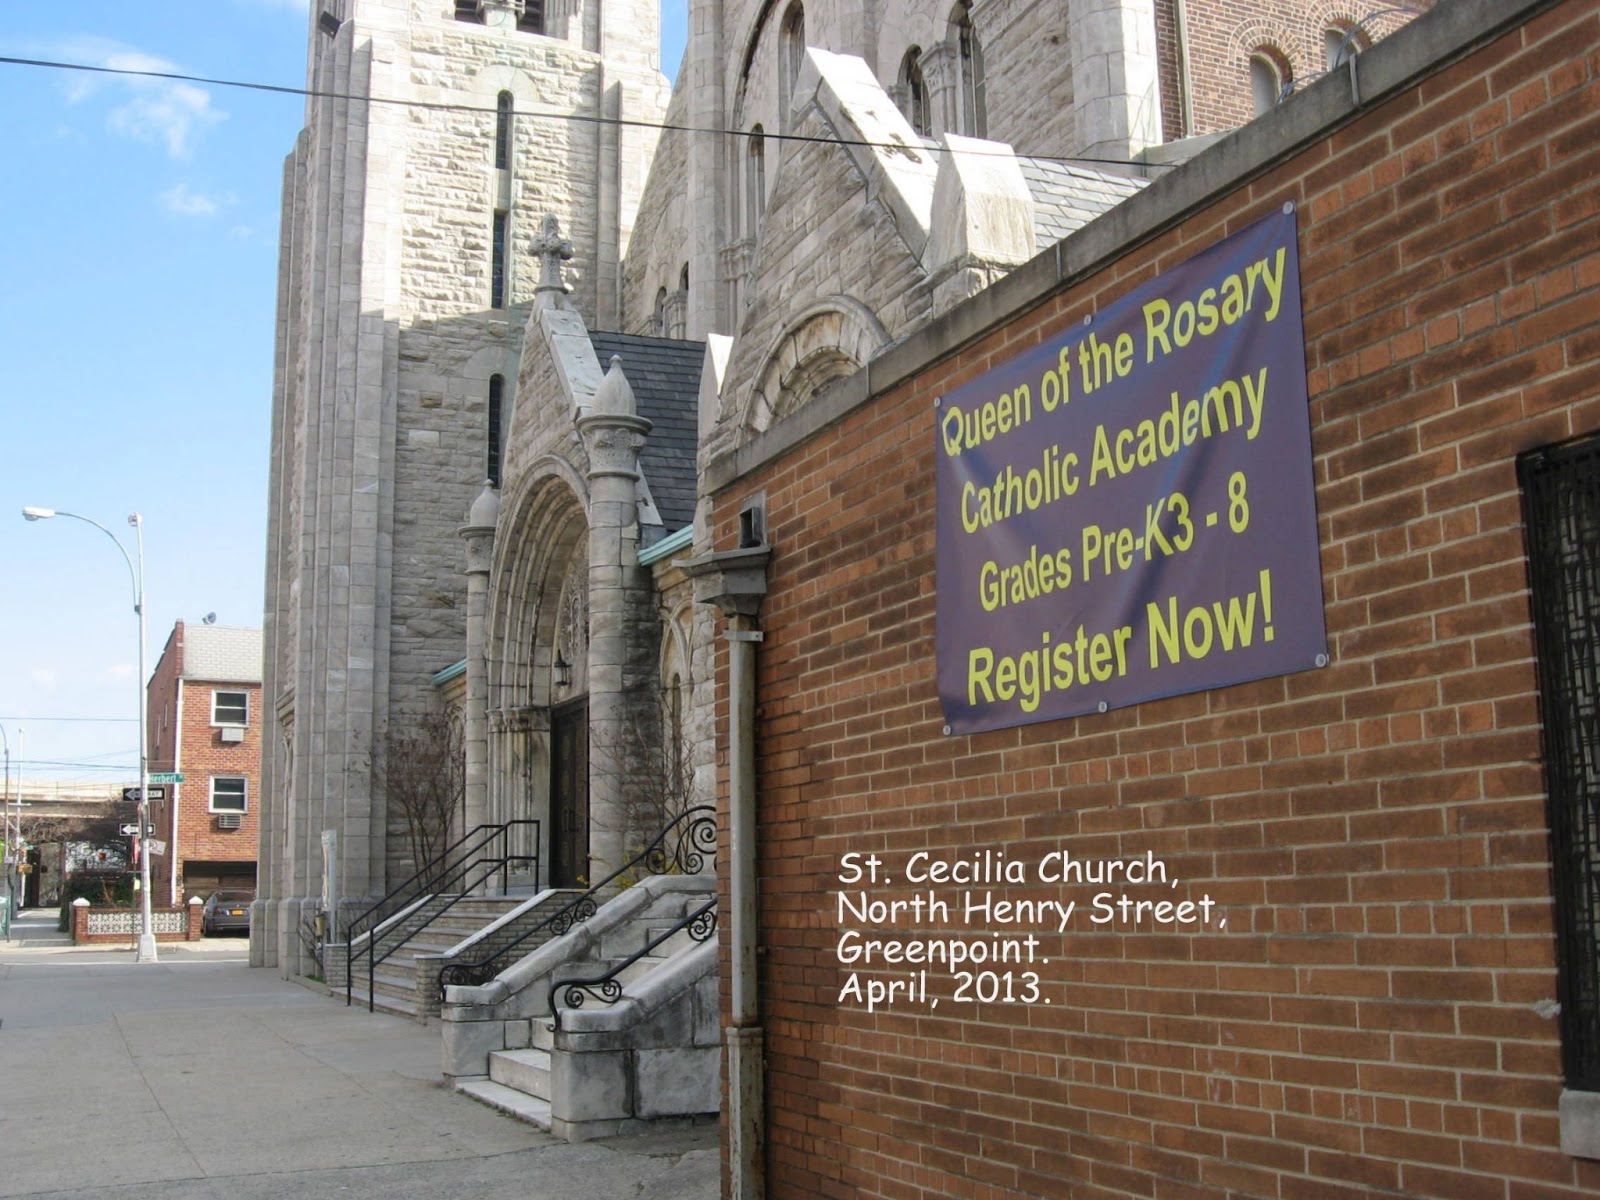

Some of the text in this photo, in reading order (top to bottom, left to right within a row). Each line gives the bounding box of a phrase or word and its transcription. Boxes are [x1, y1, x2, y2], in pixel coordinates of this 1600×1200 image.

[942, 247, 1286, 457] Queen of the Rosary
[961, 367, 1268, 534] Catholic Academy
[979, 545, 1072, 612] Grades
[1082, 492, 1195, 582] Pre-K3
[1228, 471, 1250, 534] 8
[967, 569, 1275, 713] Register Now!
[149, 774, 176, 783] Herbert
